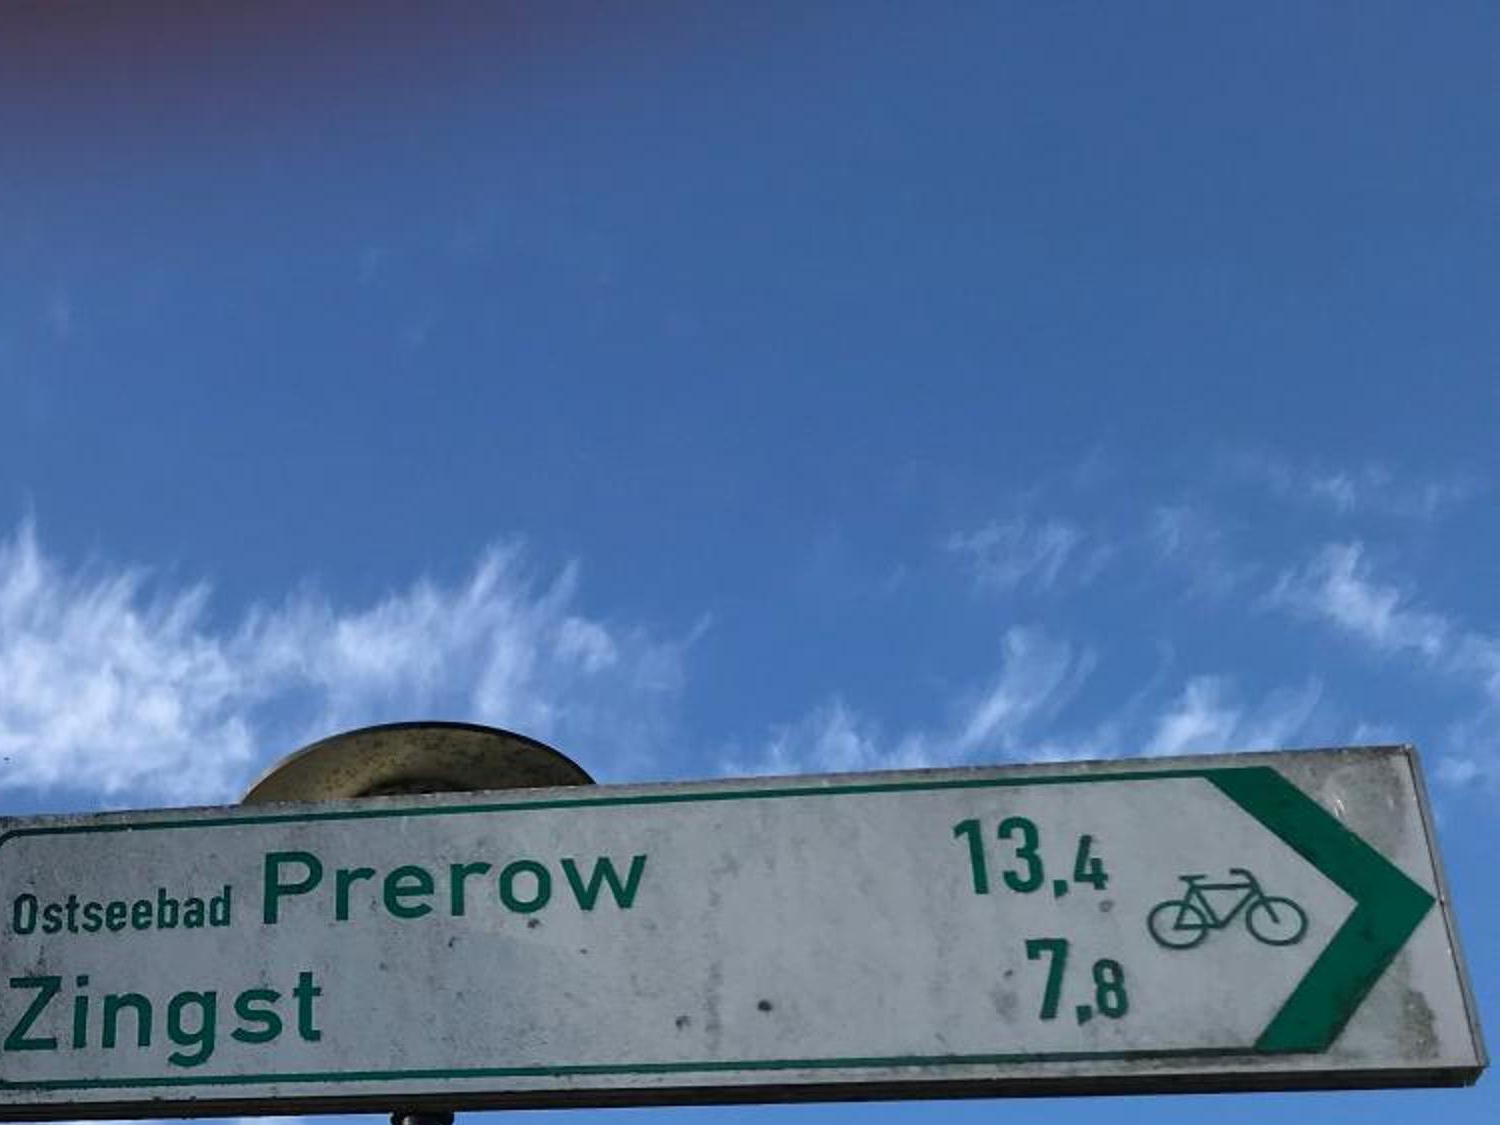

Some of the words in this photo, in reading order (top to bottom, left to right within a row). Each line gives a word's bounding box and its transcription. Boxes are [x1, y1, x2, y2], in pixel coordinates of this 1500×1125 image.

[12, 884, 233, 935] Ostseebad
[261, 850, 647, 925] Prerow
[952, 815, 1109, 899] 13,4
[2, 971, 323, 1068] Zingst
[1025, 937, 1129, 1025] 7,8
